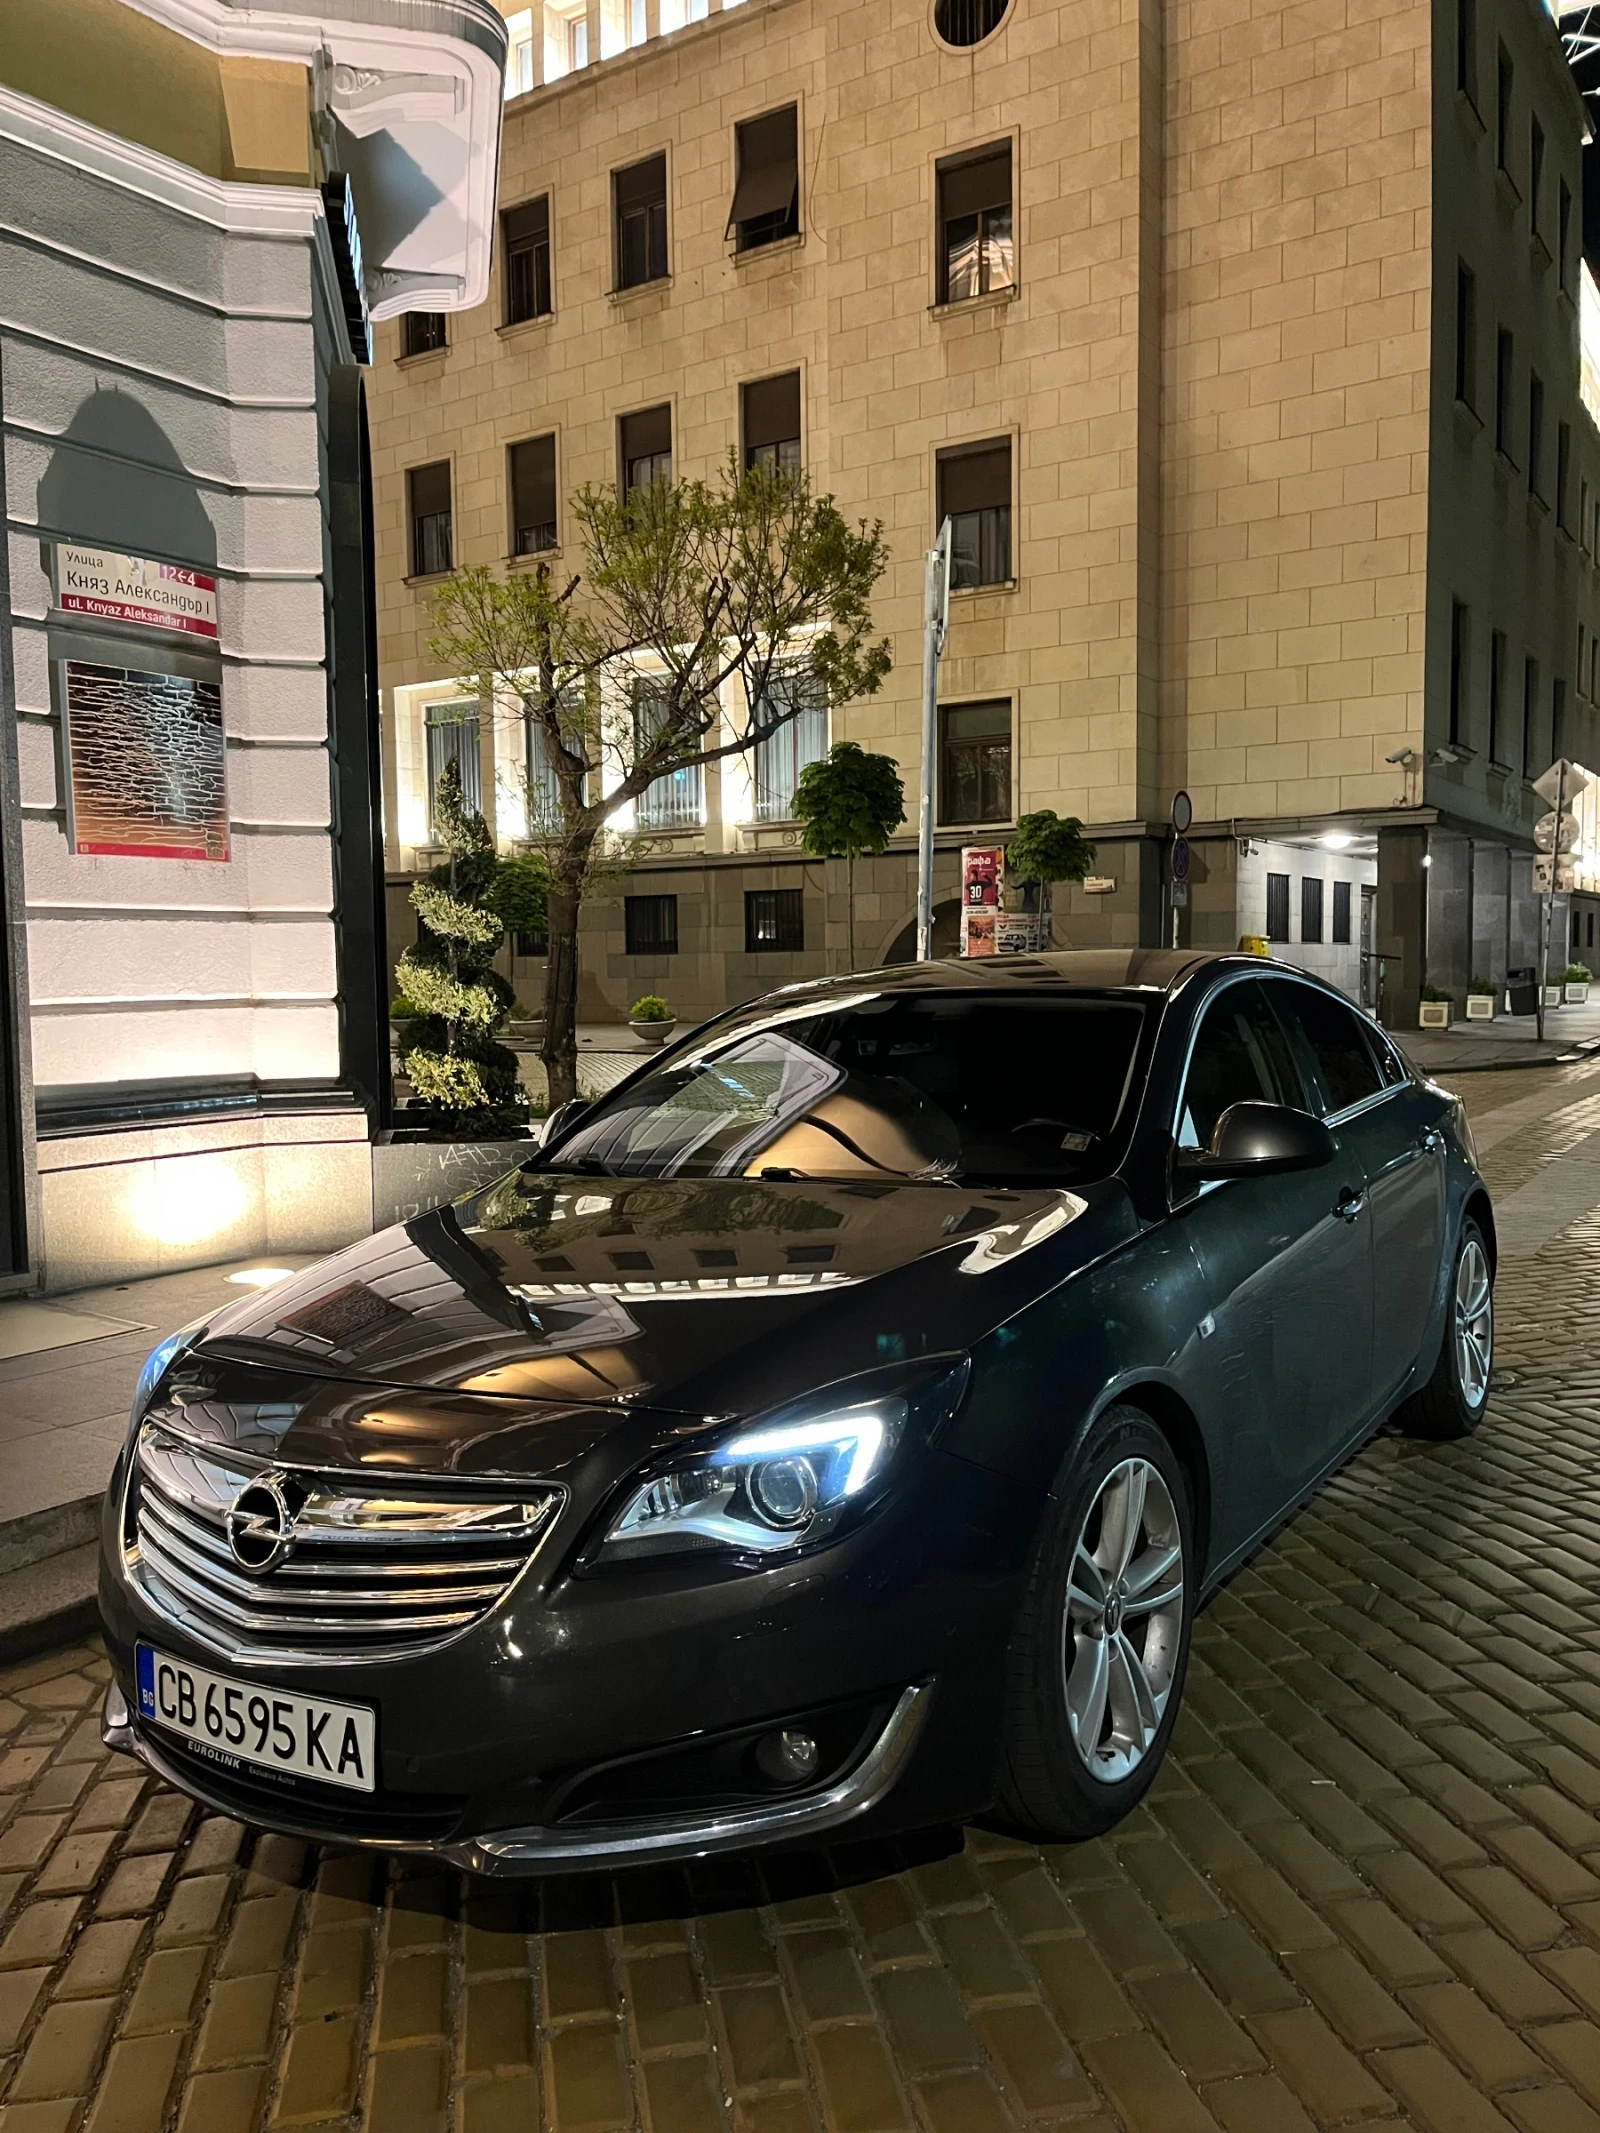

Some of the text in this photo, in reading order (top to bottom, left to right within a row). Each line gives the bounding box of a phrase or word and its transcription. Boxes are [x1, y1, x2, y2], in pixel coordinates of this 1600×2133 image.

[66, 551, 104, 569] Улица
[162, 565, 196, 586] 12 4
[67, 570, 109, 595] Княз
[115, 579, 203, 615] Александър
[68, 598, 84, 610] ul.
[86, 599, 121, 617] Knyaz
[124, 606, 181, 627] Aleksandar
[970, 885, 982, 899] 30
[142, 1688, 154, 1707] BG
[205, 1683, 296, 1760] 6595
[187, 1740, 241, 1769] EUROLINK
